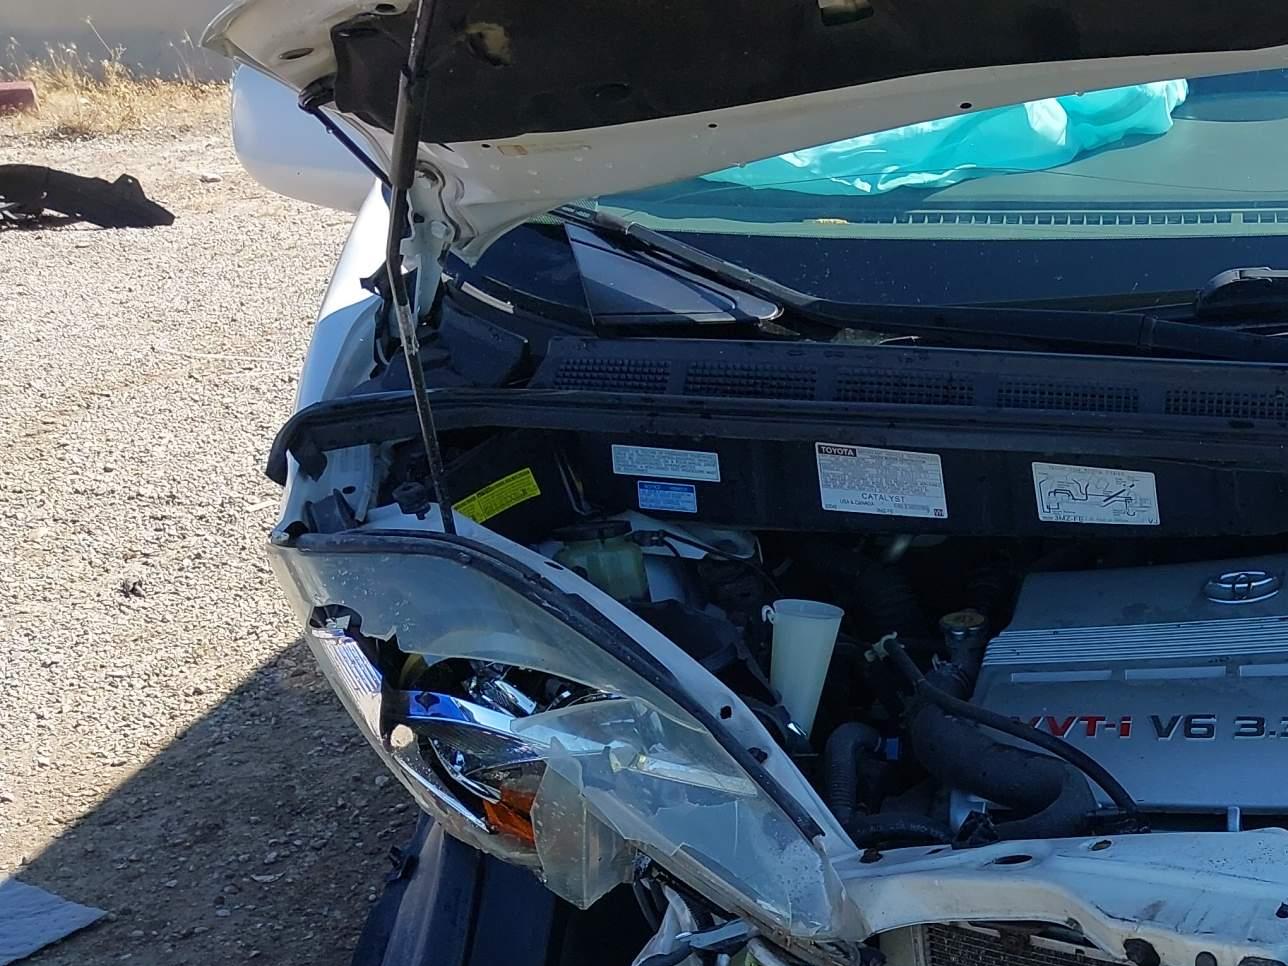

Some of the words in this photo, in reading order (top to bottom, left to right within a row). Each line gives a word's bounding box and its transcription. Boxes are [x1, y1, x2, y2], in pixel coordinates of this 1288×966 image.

[821, 446, 855, 457] TOYOTA
[861, 492, 905, 503] CATALYST
[1150, 713, 1216, 741] V6
